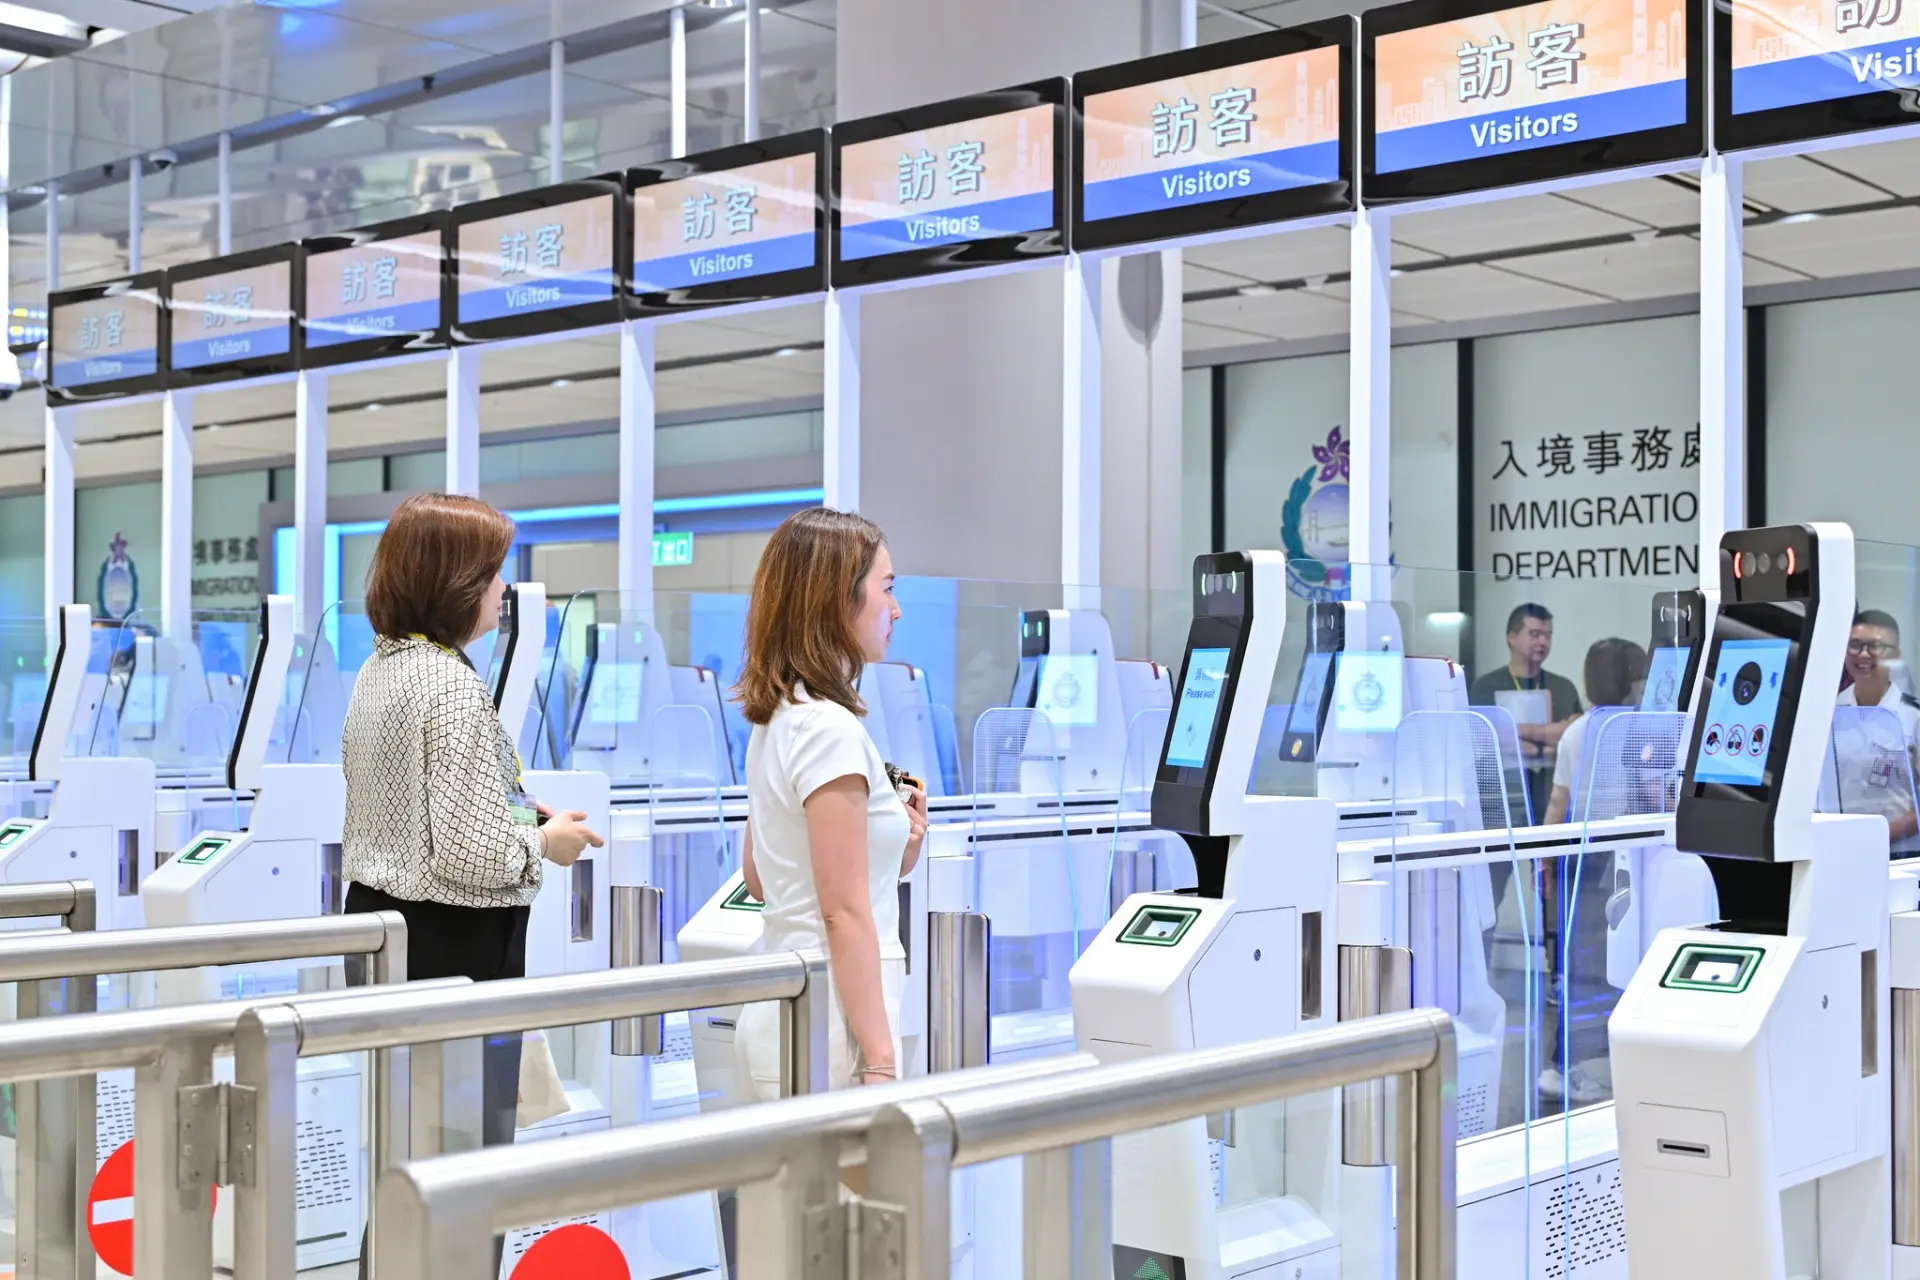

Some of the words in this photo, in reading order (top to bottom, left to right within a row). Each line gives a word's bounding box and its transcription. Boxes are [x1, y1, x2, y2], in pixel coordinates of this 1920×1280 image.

[1456, 23, 1587, 103] 訪客
[1152, 86, 1258, 158] 訪客
[1469, 112, 1579, 148] Visitors
[897, 140, 987, 205] 訪客
[1161, 167, 1251, 199] Visitors
[681, 184, 759, 243] 訪客
[905, 213, 981, 242] Visitors
[500, 223, 565, 277] 訪客
[689, 250, 754, 278] Visitors
[341, 256, 398, 305] 訪客
[505, 285, 561, 309] Visitors
[203, 285, 253, 329] 訪客
[346, 313, 396, 333] Visitors
[80, 309, 125, 351] 訪客
[208, 337, 251, 358] Visitors
[84, 360, 123, 378] Visitors
[1186, 688, 1203, 699] Please
[1204, 688, 1216, 699] wait
